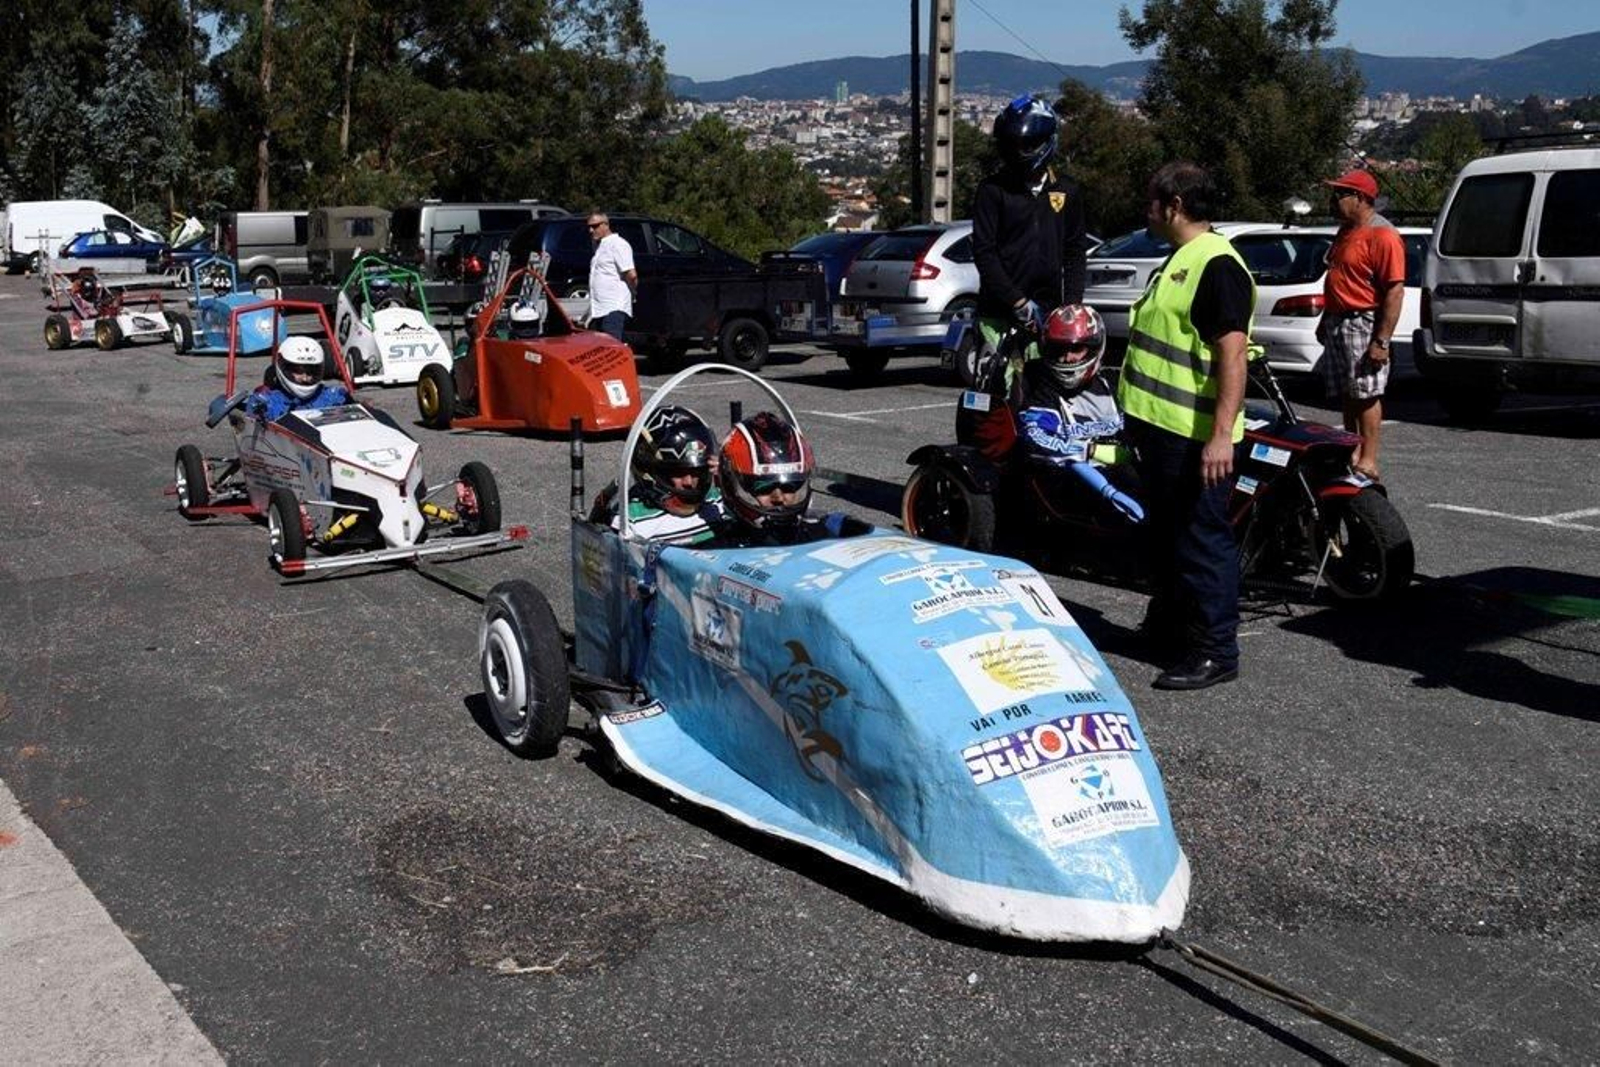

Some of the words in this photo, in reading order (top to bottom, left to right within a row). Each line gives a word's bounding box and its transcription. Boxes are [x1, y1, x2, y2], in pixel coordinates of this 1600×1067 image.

[388, 343, 440, 359] STV
[1002, 703, 1032, 721] POR
[1051, 800, 1129, 829] GAROCAPRIM
